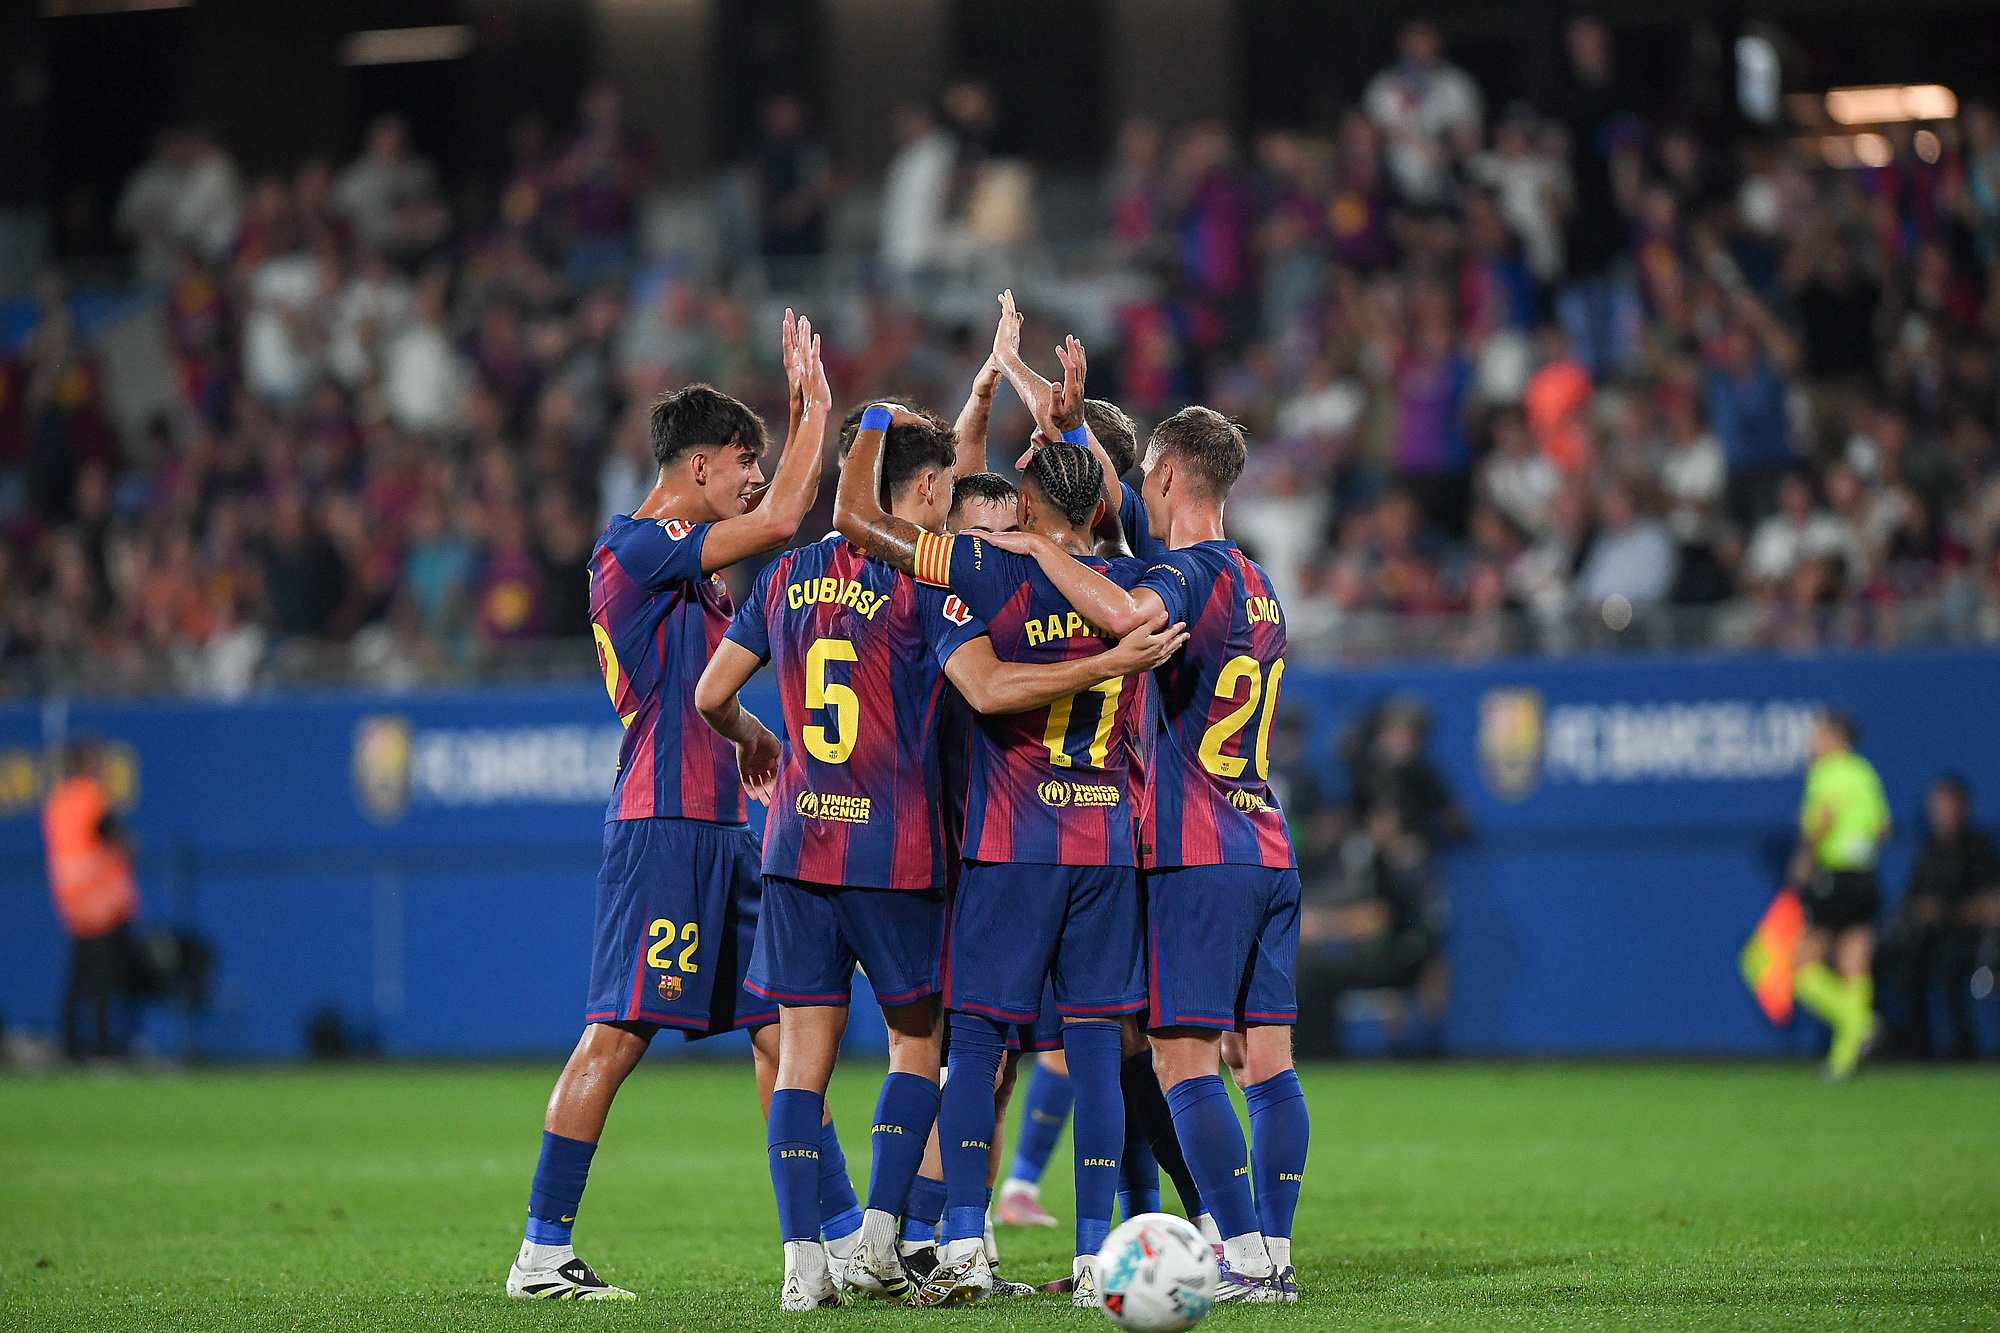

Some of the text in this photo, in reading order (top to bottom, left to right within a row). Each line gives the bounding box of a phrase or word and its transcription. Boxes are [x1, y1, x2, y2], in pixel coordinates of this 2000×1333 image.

[1246, 596, 1280, 625] OLMO
[803, 638, 860, 764] 5
[1072, 782, 1119, 793] UNHCR
[821, 793, 871, 808] UNHCR
[1074, 792, 1120, 803] ACNUR
[820, 805, 870, 820] ACNUR
[647, 918, 699, 973] 22
